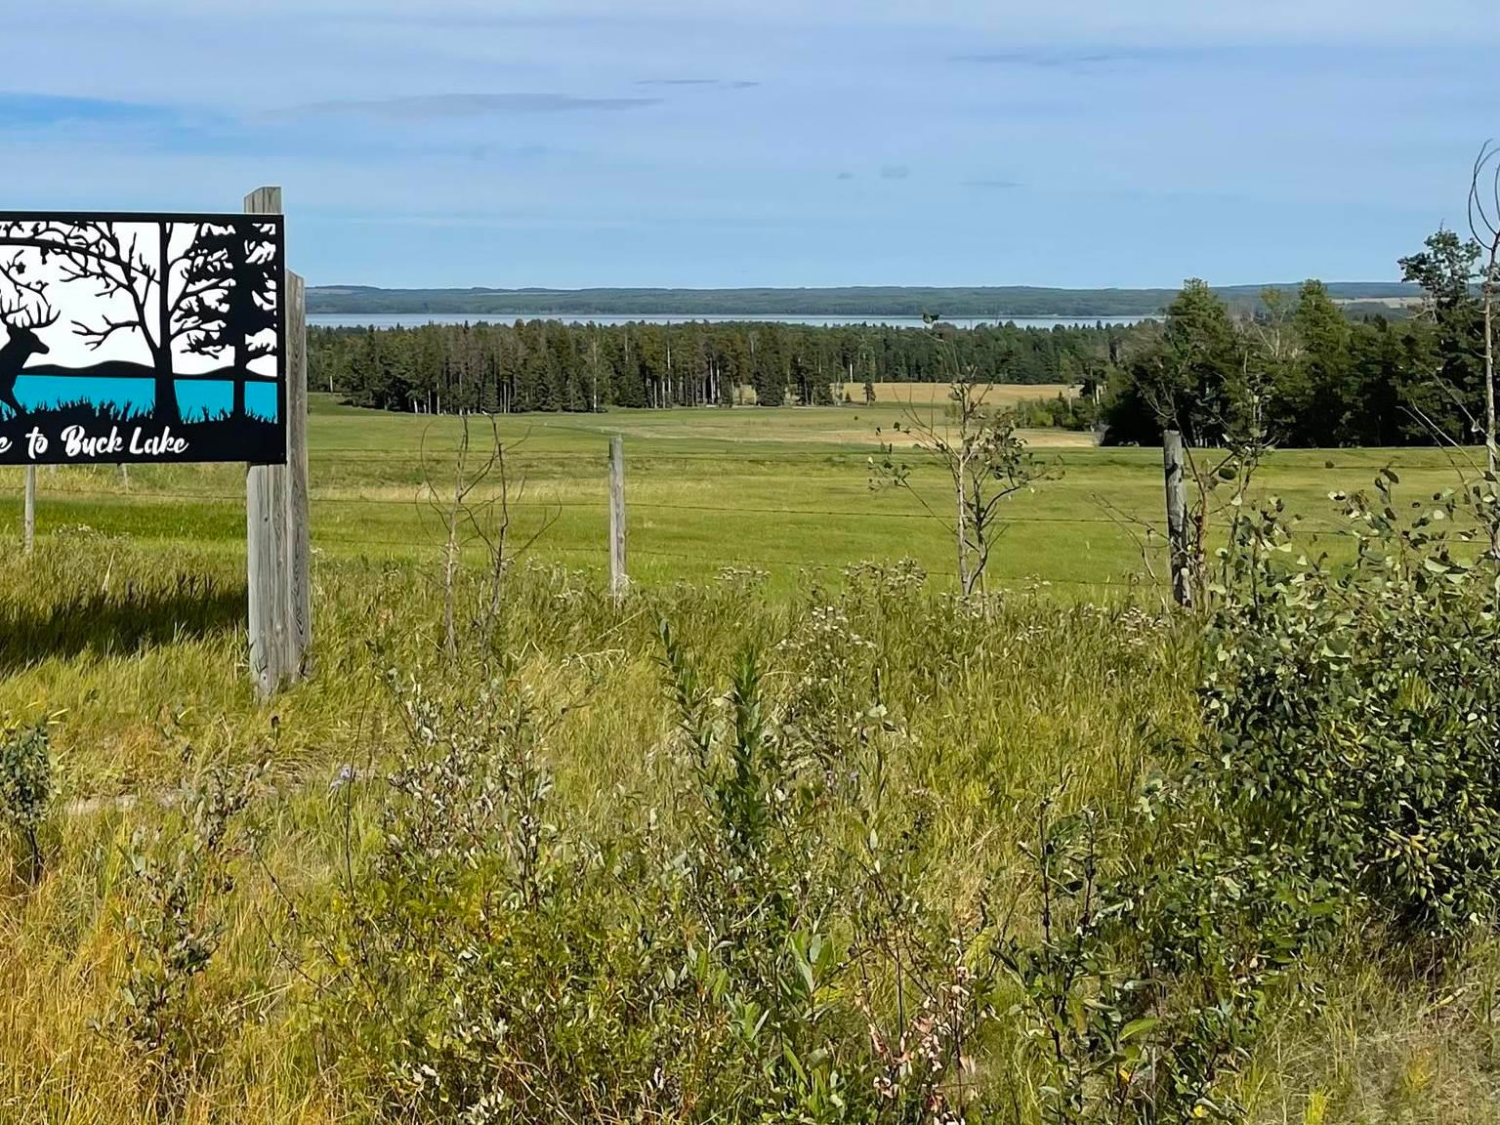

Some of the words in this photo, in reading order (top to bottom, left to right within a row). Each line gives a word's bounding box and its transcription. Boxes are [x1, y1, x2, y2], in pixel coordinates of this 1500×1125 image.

[25, 426, 49, 460] to
[60, 424, 124, 457] Buck
[129, 425, 190, 456] Lake
